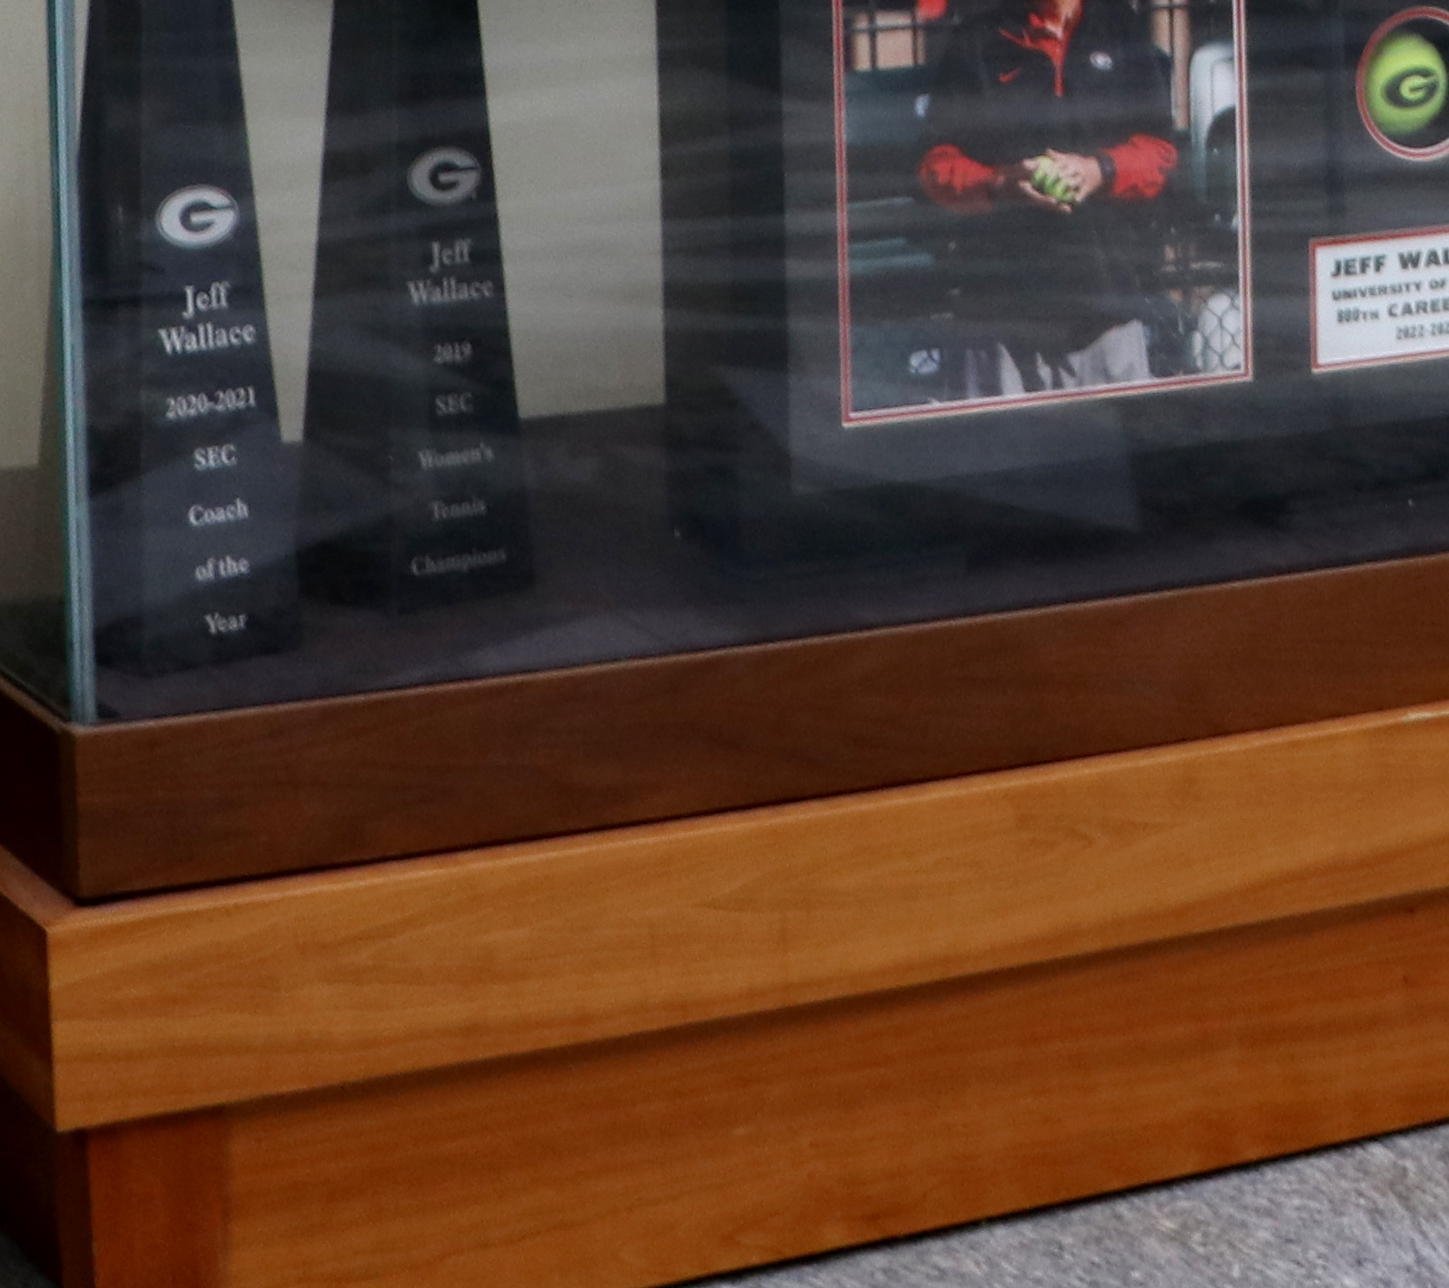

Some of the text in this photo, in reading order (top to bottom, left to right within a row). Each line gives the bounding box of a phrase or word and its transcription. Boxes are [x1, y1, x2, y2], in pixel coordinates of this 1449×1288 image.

[406, 145, 482, 206] G
[155, 182, 239, 248] G
[429, 238, 473, 273] Jeff
[1330, 254, 1387, 278] JEFF
[182, 281, 232, 319] Jeff
[407, 275, 494, 307] Wallace
[1331, 281, 1423, 302] UNIVERSITY
[1429, 277, 1448, 291] OF
[158, 321, 256, 356] Wallace
[165, 385, 256, 420] 2020-2021
[435, 393, 474, 416] SEC
[193, 443, 238, 470] SEC
[418, 442, 494, 470] Women's
[187, 497, 249, 527] Coach
[428, 498, 488, 521] Tennis
[194, 555, 250, 583] of the
[203, 612, 248, 637] Year
